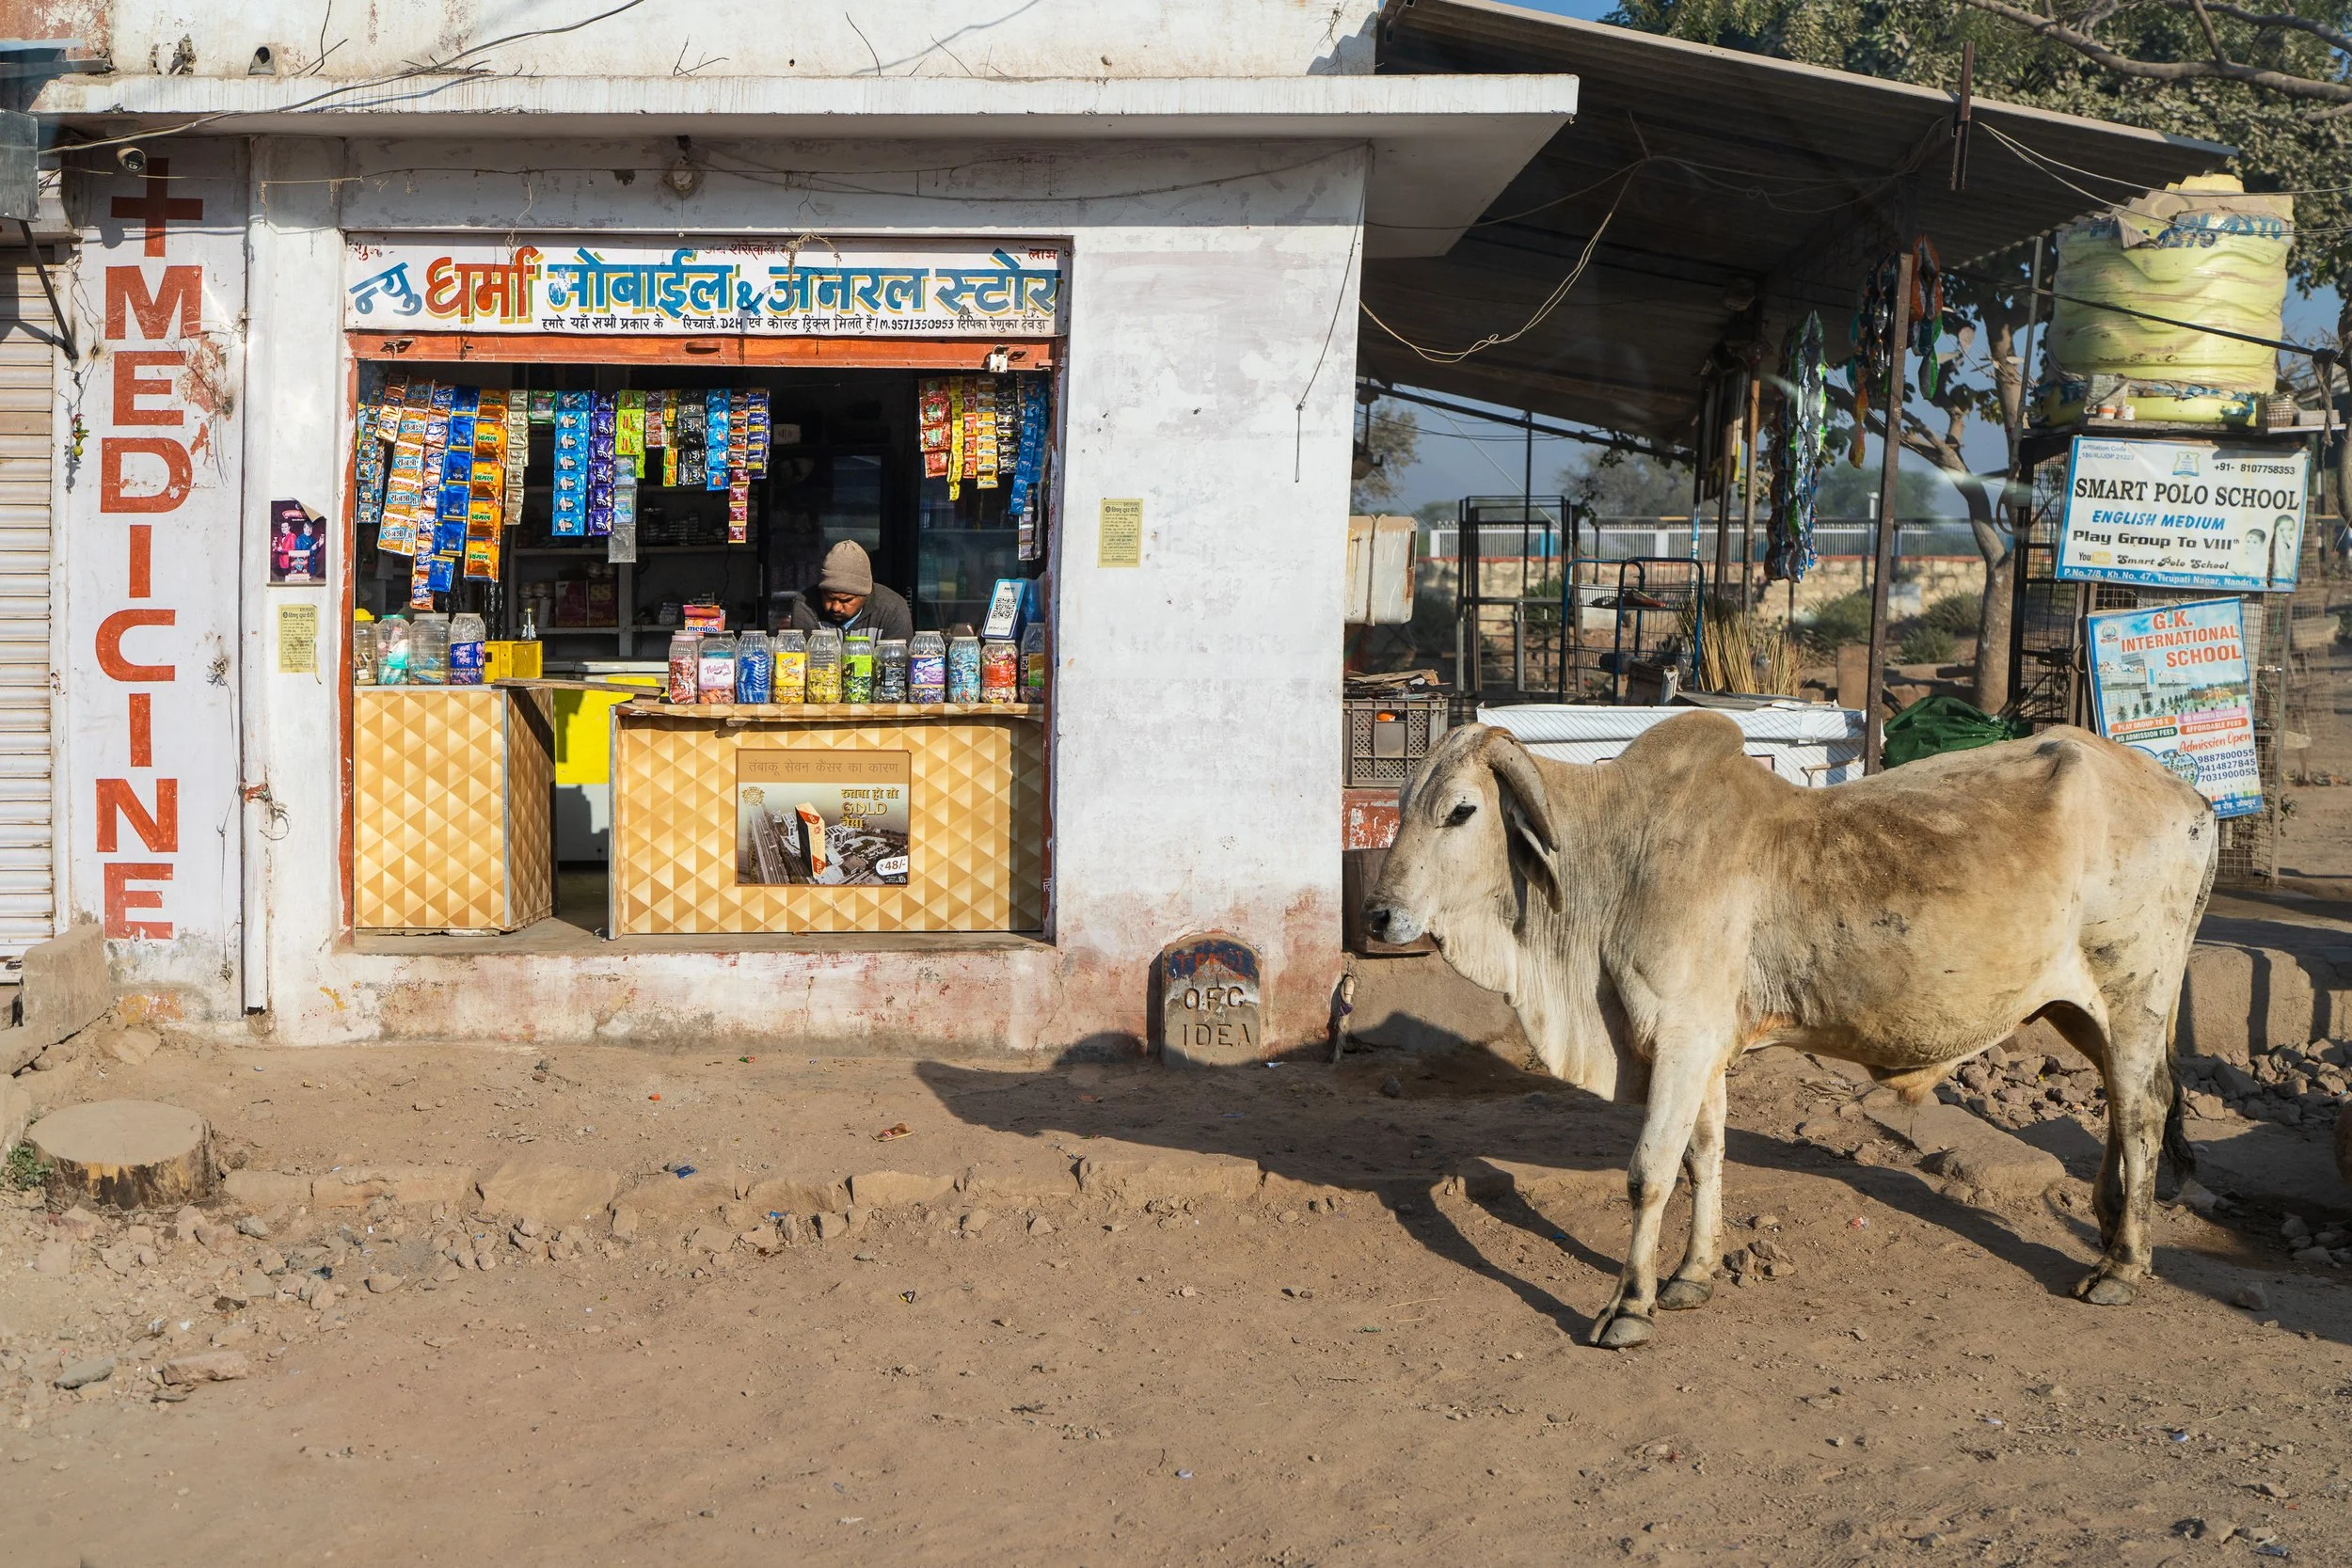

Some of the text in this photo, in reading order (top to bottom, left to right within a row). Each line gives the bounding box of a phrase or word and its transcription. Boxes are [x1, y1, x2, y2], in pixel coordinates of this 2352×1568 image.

[425, 245, 541, 323] धर्मा
[548, 246, 734, 319] मोबाईल
[736, 280, 765, 316] &
[767, 265, 930, 311] जनरल
[934, 247, 1061, 312] स्टोर
[542, 314, 565, 329] हमारे
[570, 313, 590, 328] यहाँ
[593, 315, 616, 328] सभी
[620, 318, 649, 329] प्रकार
[653, 313, 664, 328] के
[722, 319, 743, 328] D2H
[748, 315, 763, 328] एवं
[767, 315, 799, 329] कोल्ड
[834, 313, 864, 329] मिलते
[990, 315, 1018, 332] रेणुका
[2214, 462, 2296, 475] +91- 8107758353
[2074, 478, 2300, 511] SMART POLO SCHOOL
[2091, 510, 2226, 531] ENGLISH MEDIUM
[2073, 530, 2112, 546] Play
[2118, 532, 2171, 549] Group
[2177, 536, 2197, 548] To
[2117, 554, 2155, 565] Smart
[2156, 556, 2185, 567] Polo
[2190, 559, 2230, 570] School
[2157, 574, 2191, 584] Tirupati
[2193, 575, 2221, 587] Nagar,
[95, 265, 201, 940] MEDICINE
[687, 625, 718, 633] mentos
[2153, 610, 2194, 631] G.K.
[2122, 625, 2239, 653] INTERNATIONAL
[2166, 644, 2242, 668] SCHOOL
[2133, 721, 2153, 729] GROUP
[2185, 720, 2243, 733] AFFORDABLE FEES
[2125, 731, 2158, 741] ADMISSION
[2159, 728, 2175, 736] FEES
[2179, 731, 2251, 753] Admission Open
[2198, 749, 2255, 764] 9887800055
[2199, 758, 2256, 773] 9414827845
[748, 758, 781, 776] तंबाकू
[784, 758, 809, 773] सेवन
[849, 762, 862, 773] का
[868, 762, 898, 773] कारण
[2201, 768, 2257, 783] 7031900055
[841, 801, 888, 816] GOLD
[1183, 1022, 1252, 1048] IDEA
